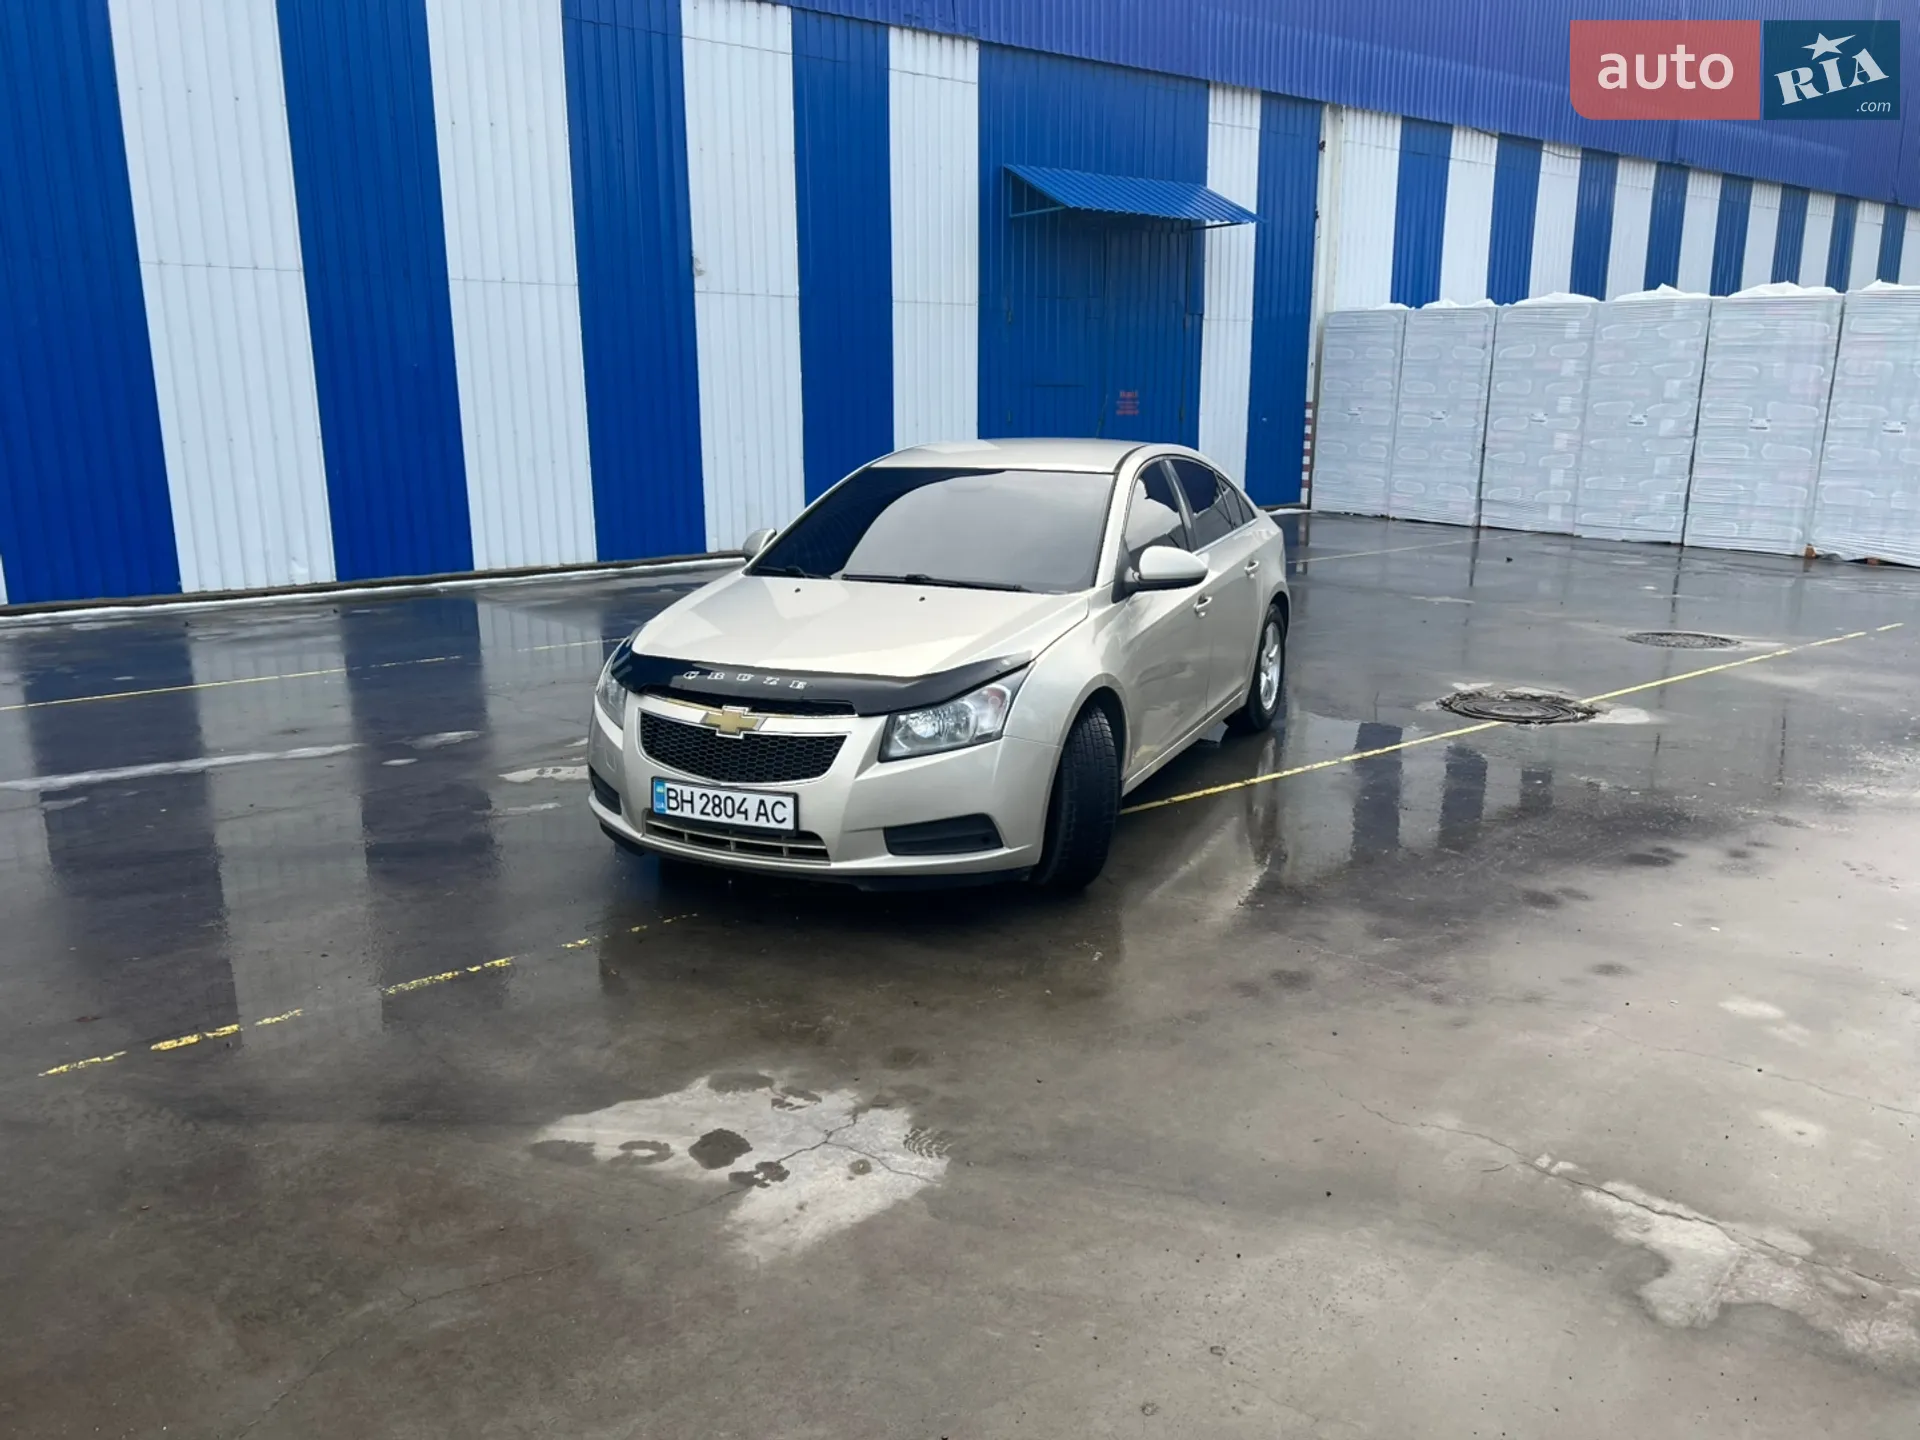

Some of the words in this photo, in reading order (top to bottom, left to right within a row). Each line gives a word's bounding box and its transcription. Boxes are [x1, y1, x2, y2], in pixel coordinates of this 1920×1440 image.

[666, 787, 695, 814] BH
[699, 793, 749, 821] 2804
[755, 798, 788, 824] AC
